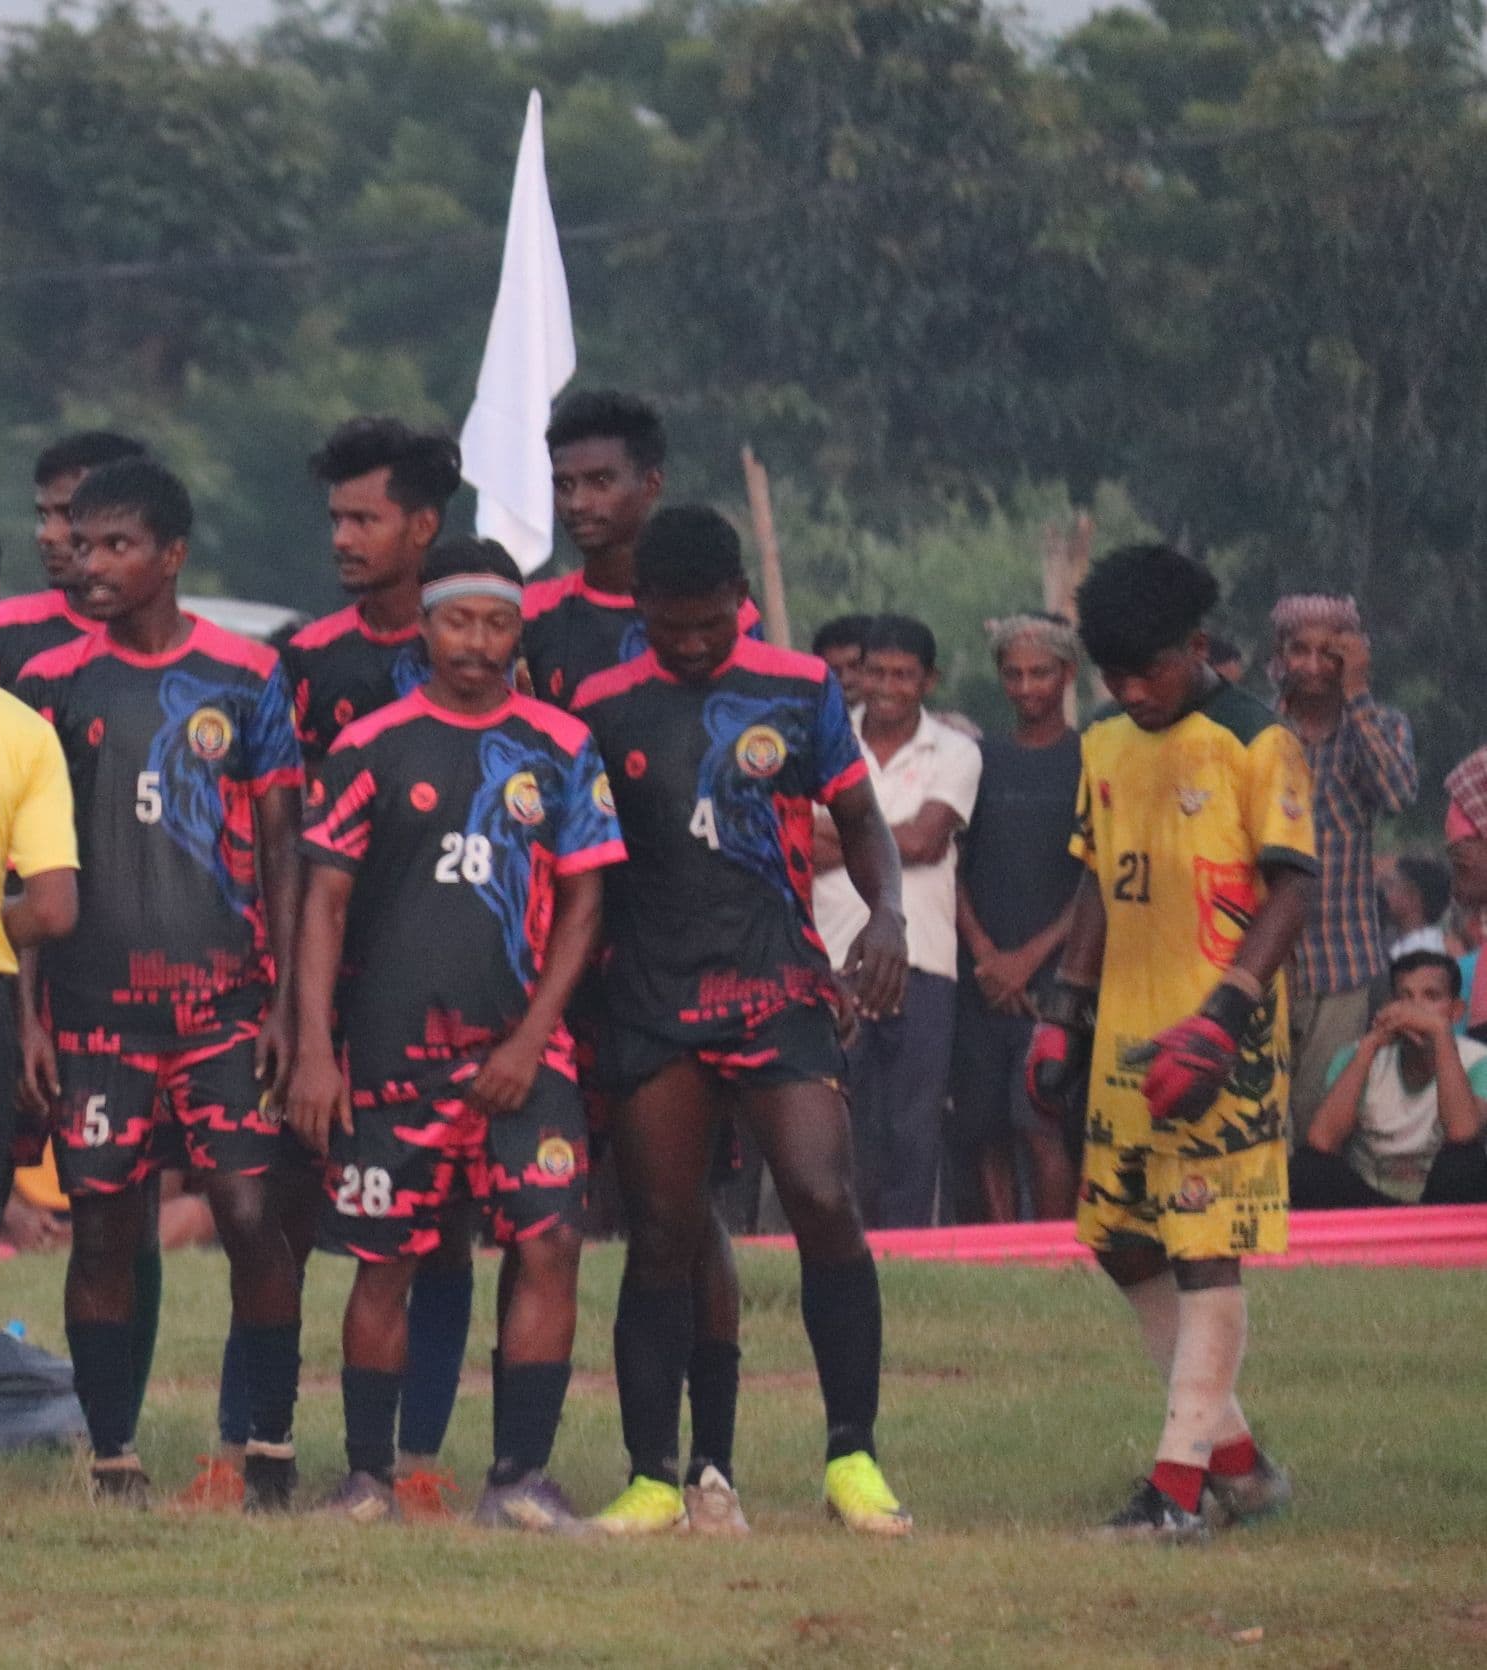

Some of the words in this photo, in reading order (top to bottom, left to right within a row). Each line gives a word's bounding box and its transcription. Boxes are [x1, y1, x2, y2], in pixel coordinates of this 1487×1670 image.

[135, 770, 162, 824] 5
[689, 796, 720, 850] 4
[434, 831, 492, 884] 28
[1113, 850, 1150, 903] 21
[82, 1094, 110, 1147] 5
[336, 1164, 392, 1217] 28
